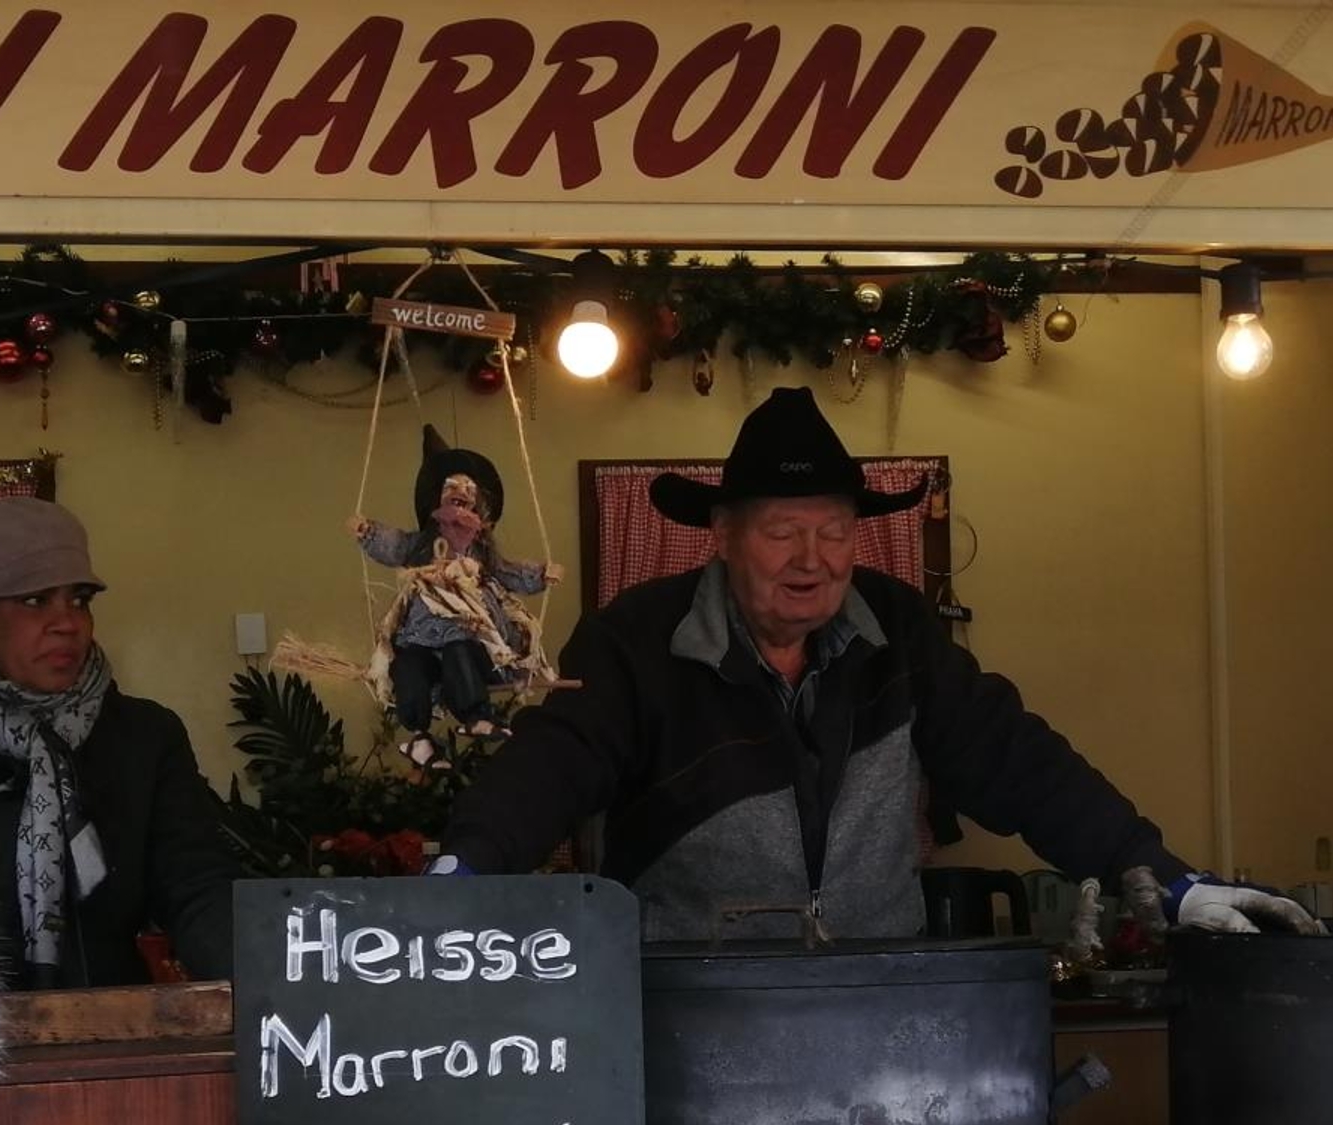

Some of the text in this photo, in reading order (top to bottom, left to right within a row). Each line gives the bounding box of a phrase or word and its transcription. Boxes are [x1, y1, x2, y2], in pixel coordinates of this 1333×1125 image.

[57, 10, 998, 190] MARRONI
[391, 304, 487, 331] welcome
[286, 904, 577, 984] Heisse
[261, 1012, 567, 1098] Marroni
